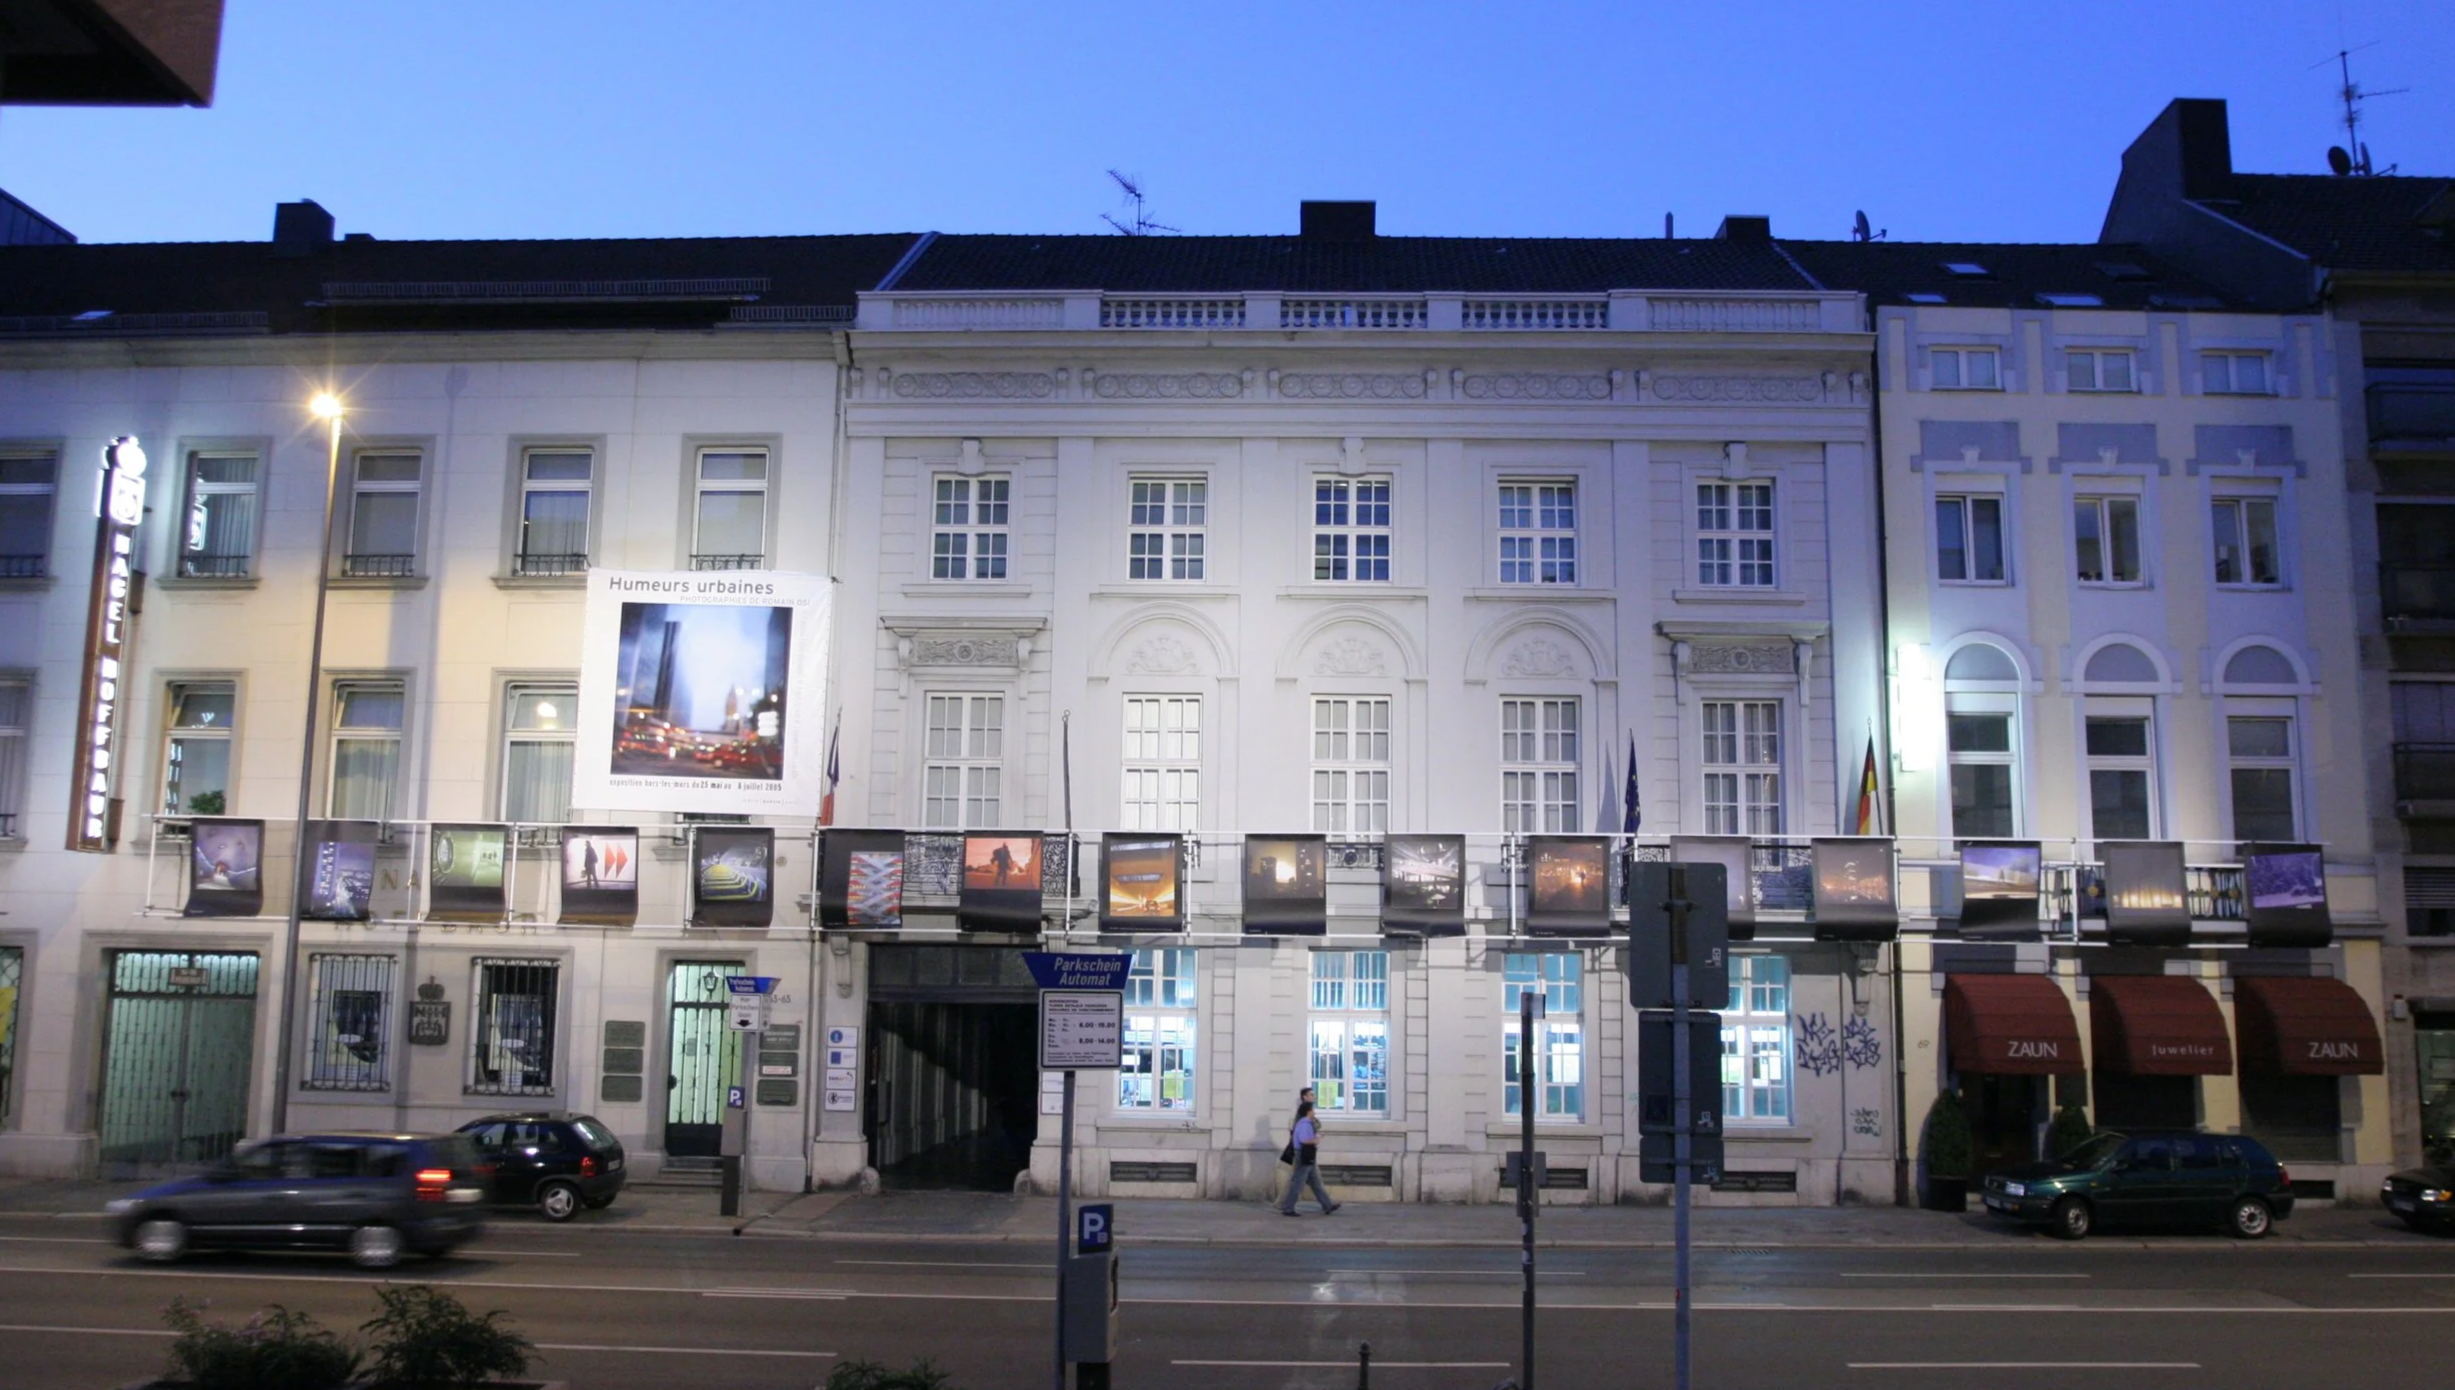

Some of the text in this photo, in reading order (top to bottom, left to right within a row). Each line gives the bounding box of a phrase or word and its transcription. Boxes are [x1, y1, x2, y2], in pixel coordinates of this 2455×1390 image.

[105, 532, 131, 644] NAGEL
[609, 576, 774, 595] Humeurs urbaines
[680, 595, 747, 605] PHOTOGRAPHIES
[749, 597, 760, 605] DE
[762, 598, 795, 606] ROMAIN
[609, 779, 643, 788] exposition
[700, 780, 708, 789] 25
[710, 781, 723, 789] mai
[743, 782, 763, 791] juillet
[765, 783, 783, 791] 2005
[1054, 956, 1122, 972] Parkschein
[1059, 972, 1111, 986] Automat
[2008, 1041, 2058, 1058] ZAUN
[2309, 1042, 2358, 1058] ZAUN
[730, 1089, 741, 1104] P
[1083, 1212, 1105, 1240] P
